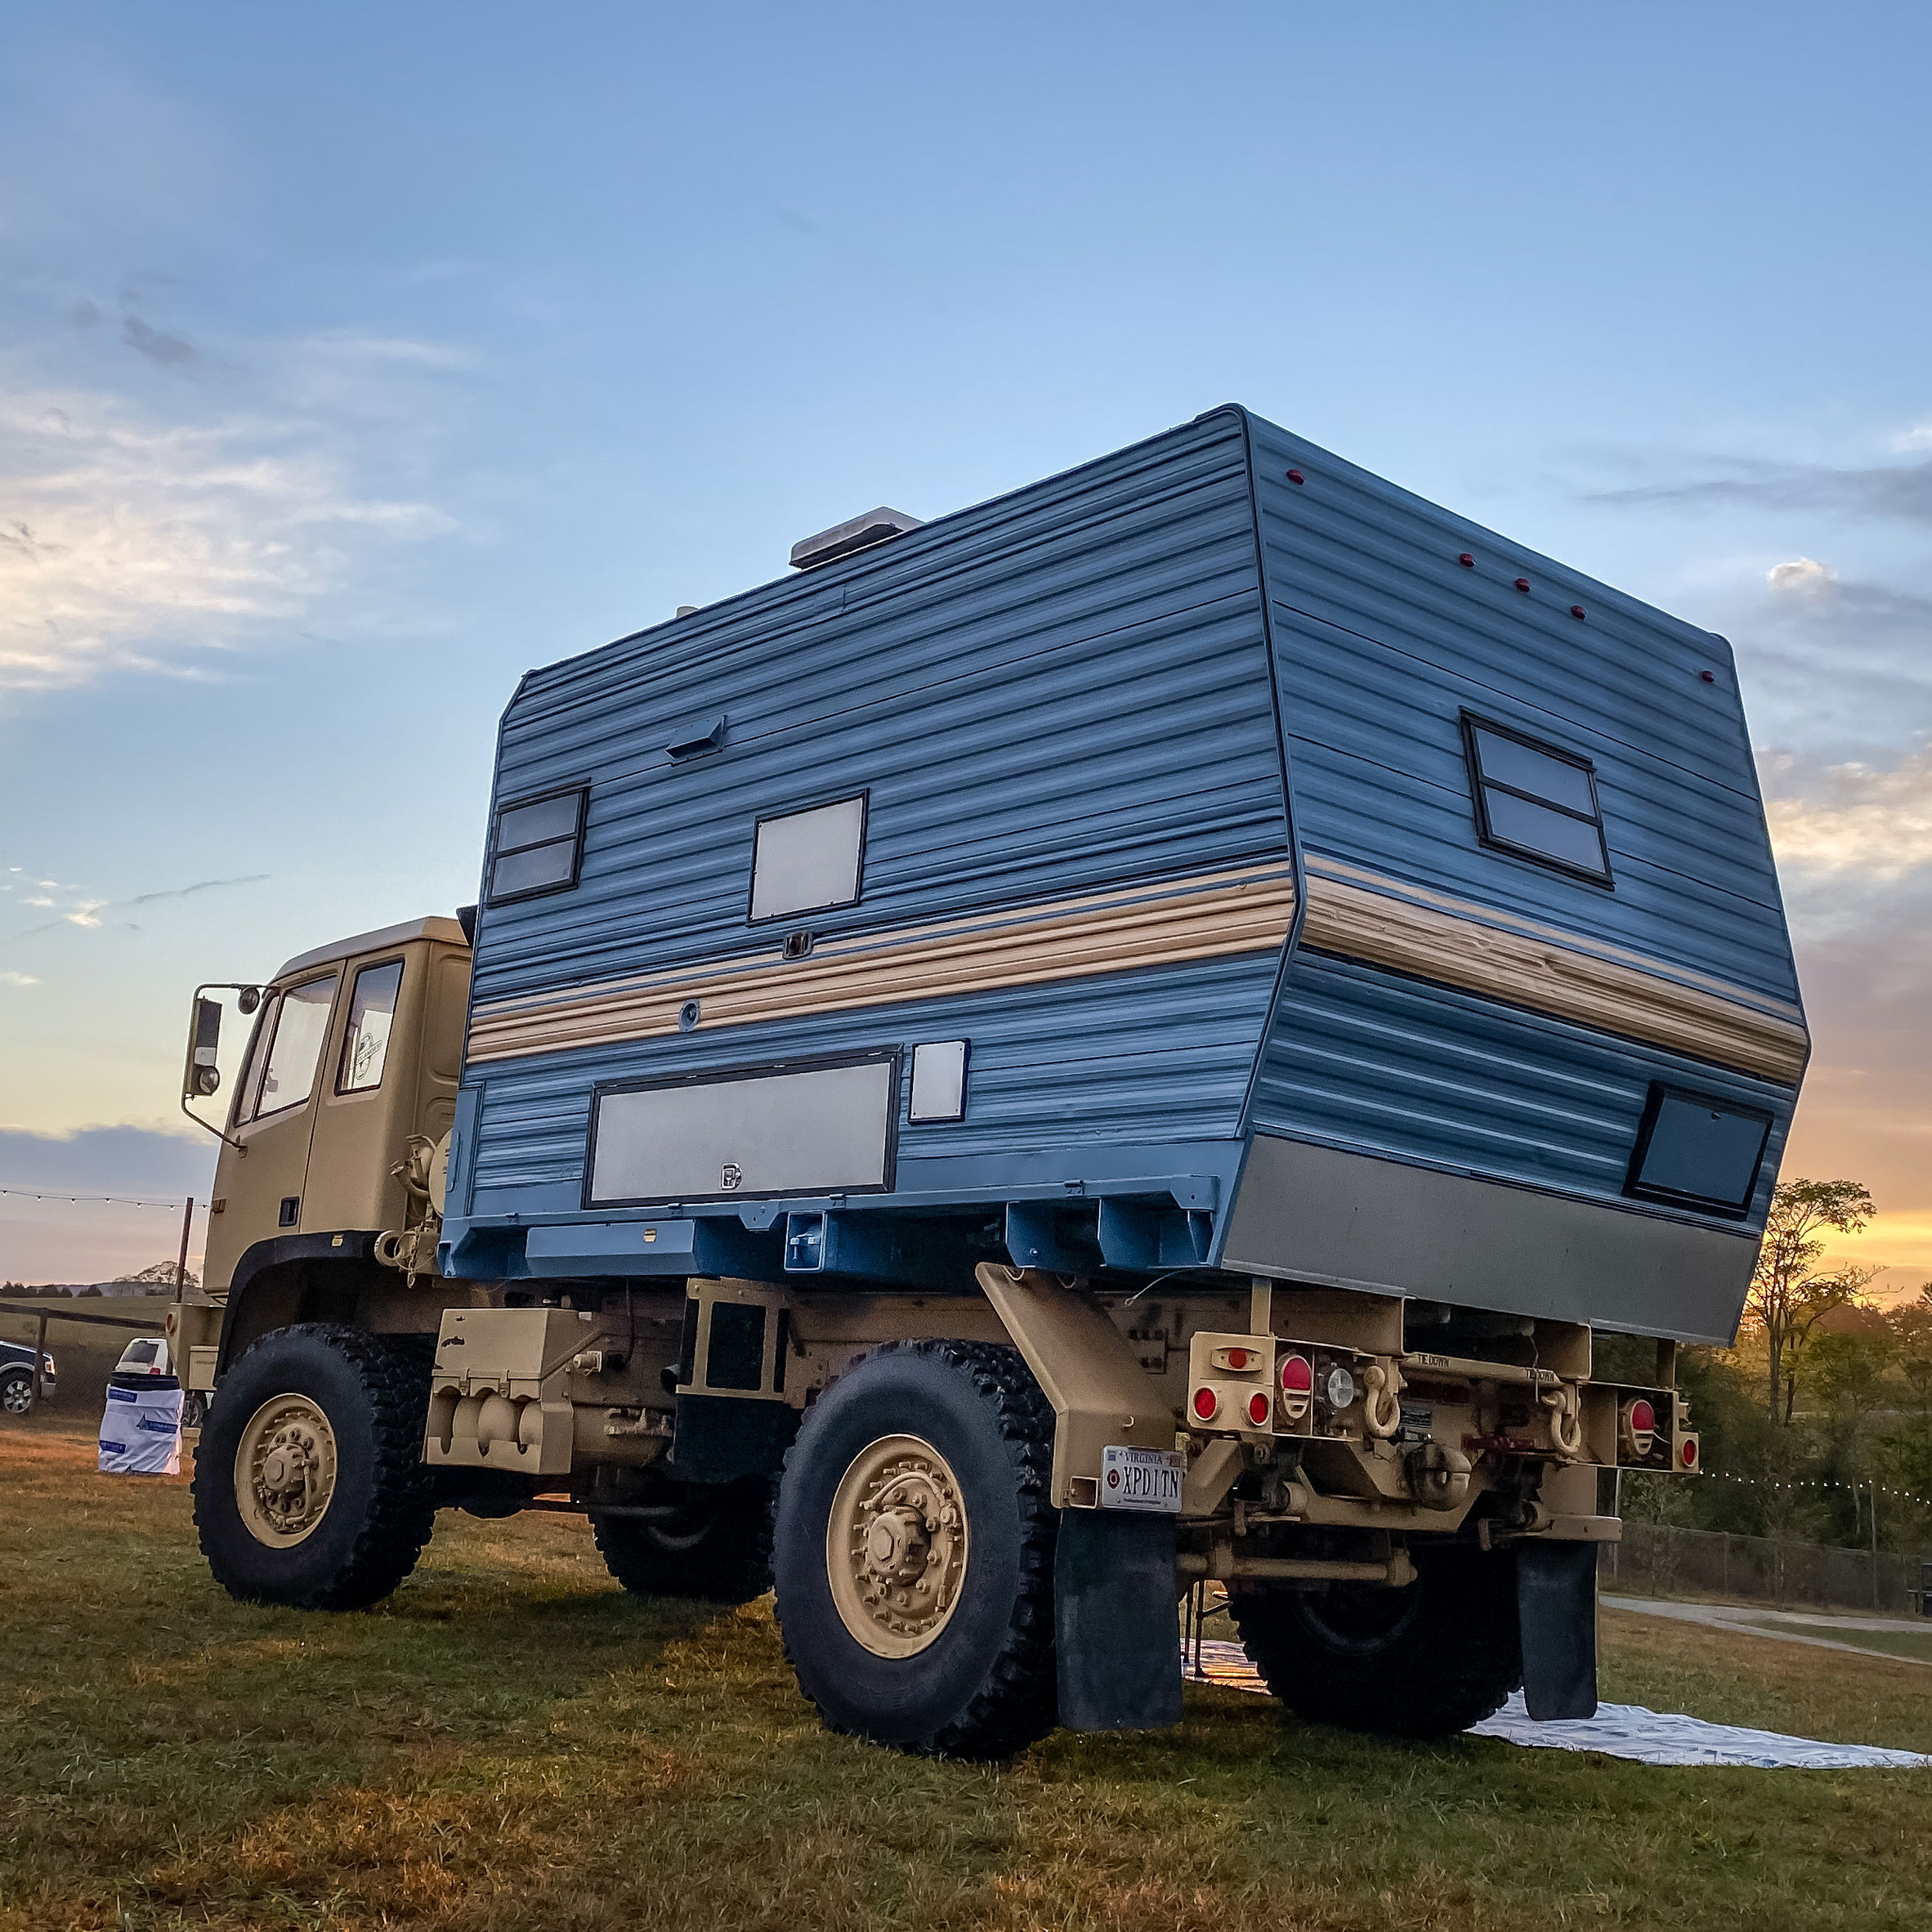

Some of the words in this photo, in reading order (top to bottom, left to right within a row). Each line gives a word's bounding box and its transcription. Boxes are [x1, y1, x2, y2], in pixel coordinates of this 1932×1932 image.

[1429, 1355, 1450, 1367] DOWN
[1125, 1451, 1163, 1465] VIRGINIA
[1123, 1466, 1178, 1498] XPDITN
